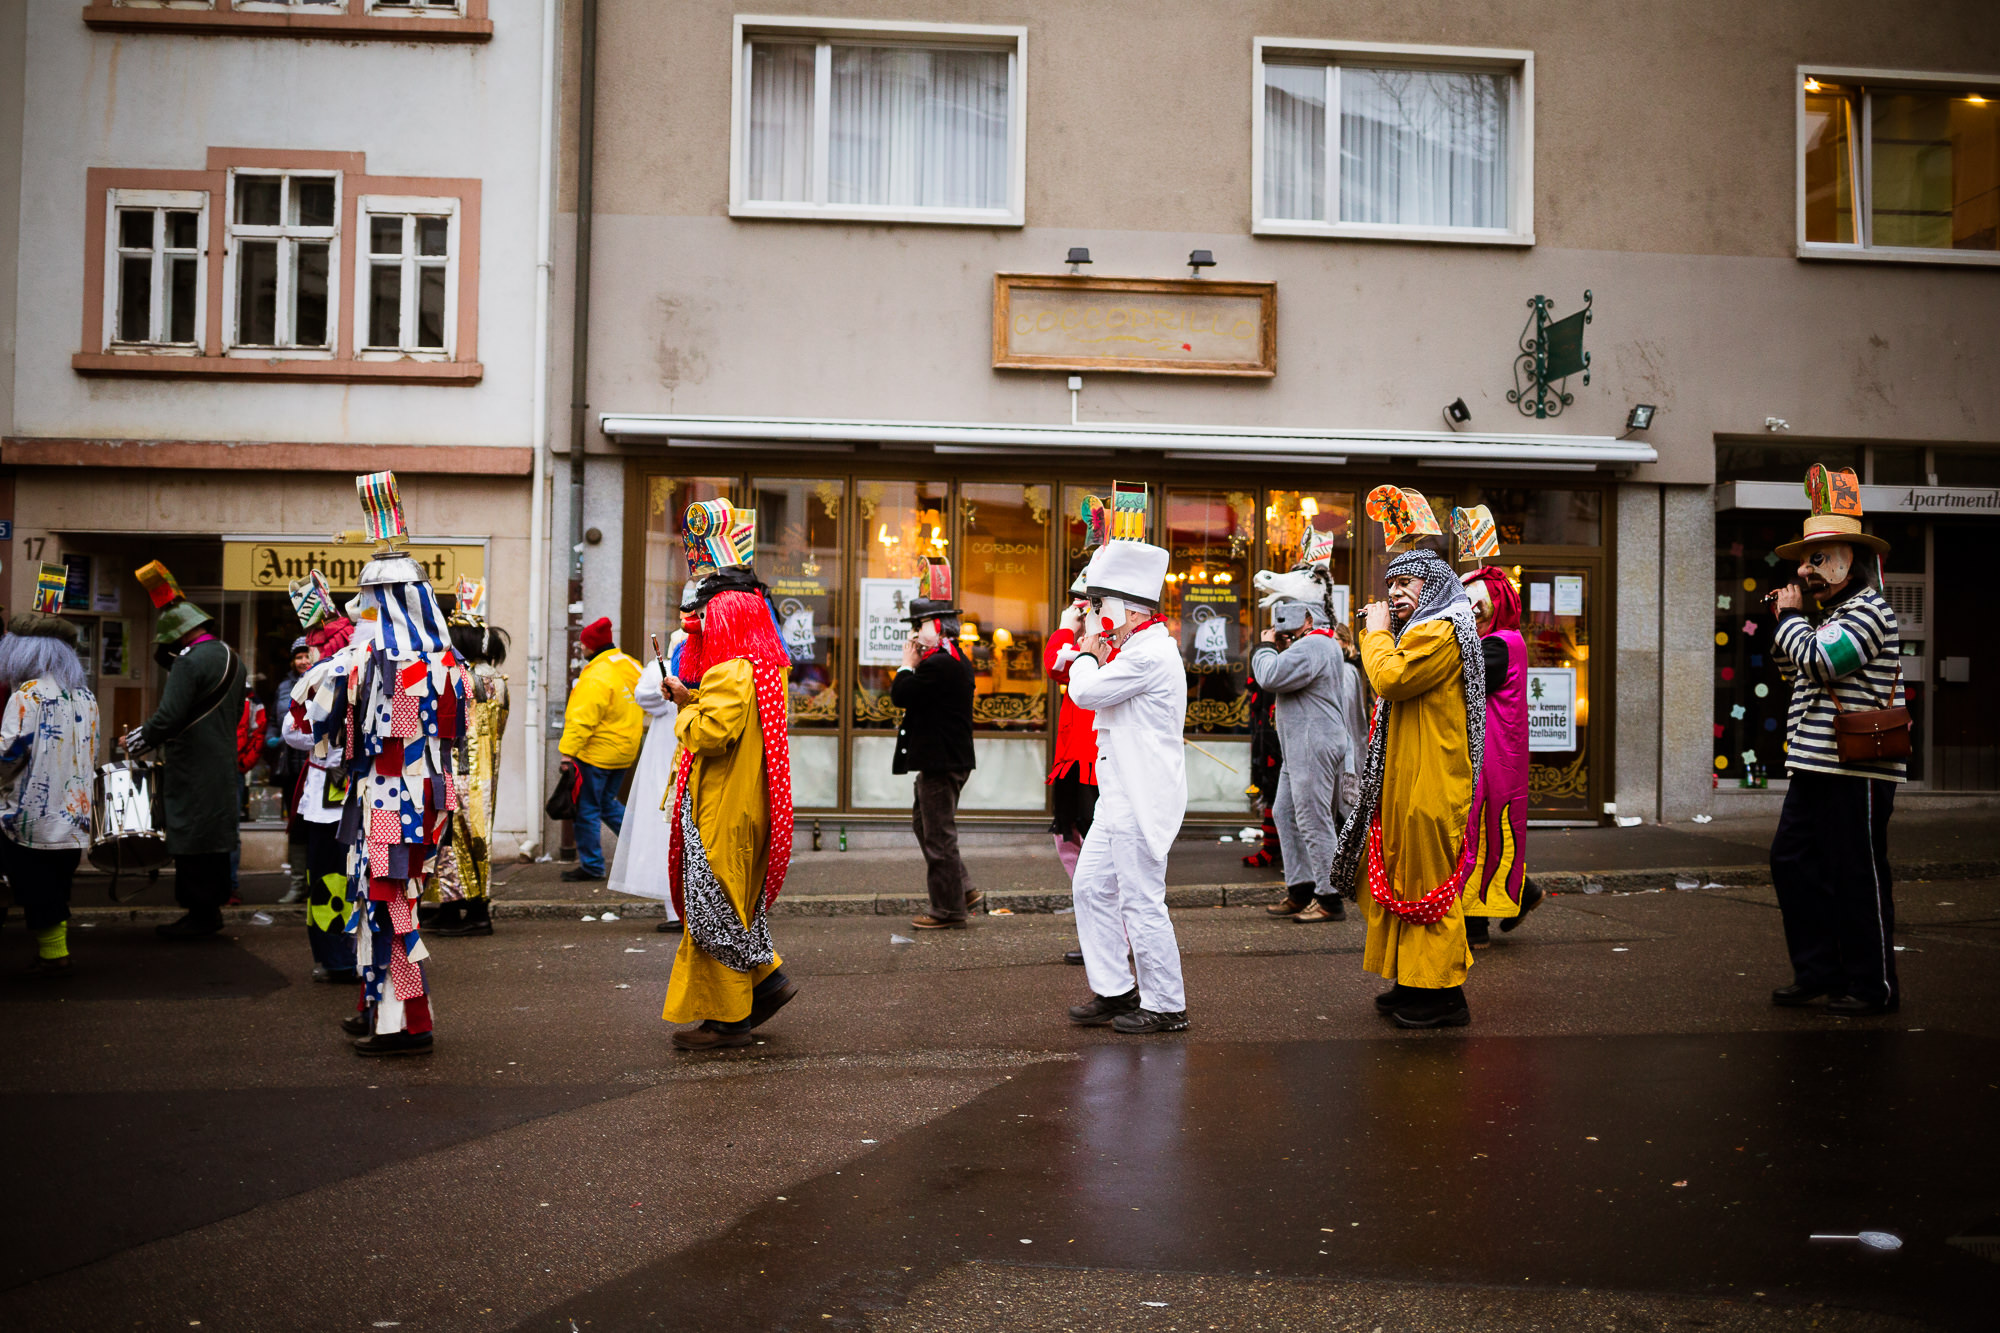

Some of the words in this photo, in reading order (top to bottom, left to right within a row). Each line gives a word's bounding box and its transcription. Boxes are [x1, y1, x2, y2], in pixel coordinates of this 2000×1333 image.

[1013, 307, 1256, 341] COCCODRILLO
[23, 537, 47, 561] 17
[971, 542, 1038, 555] CORDON
[259, 548, 446, 586] Antiquat
[984, 562, 1027, 575] BLEU
[869, 615, 880, 624] Do
[792, 630, 812, 642] SG
[869, 625, 910, 641] d'Com
[1209, 624, 1220, 636] V
[868, 641, 904, 652] Schnitze
[1205, 635, 1224, 648] SG
[1184, 662, 1245, 675] ISOTTO
[1540, 702, 1567, 711] kemme
[1528, 712, 1567, 728] omité
